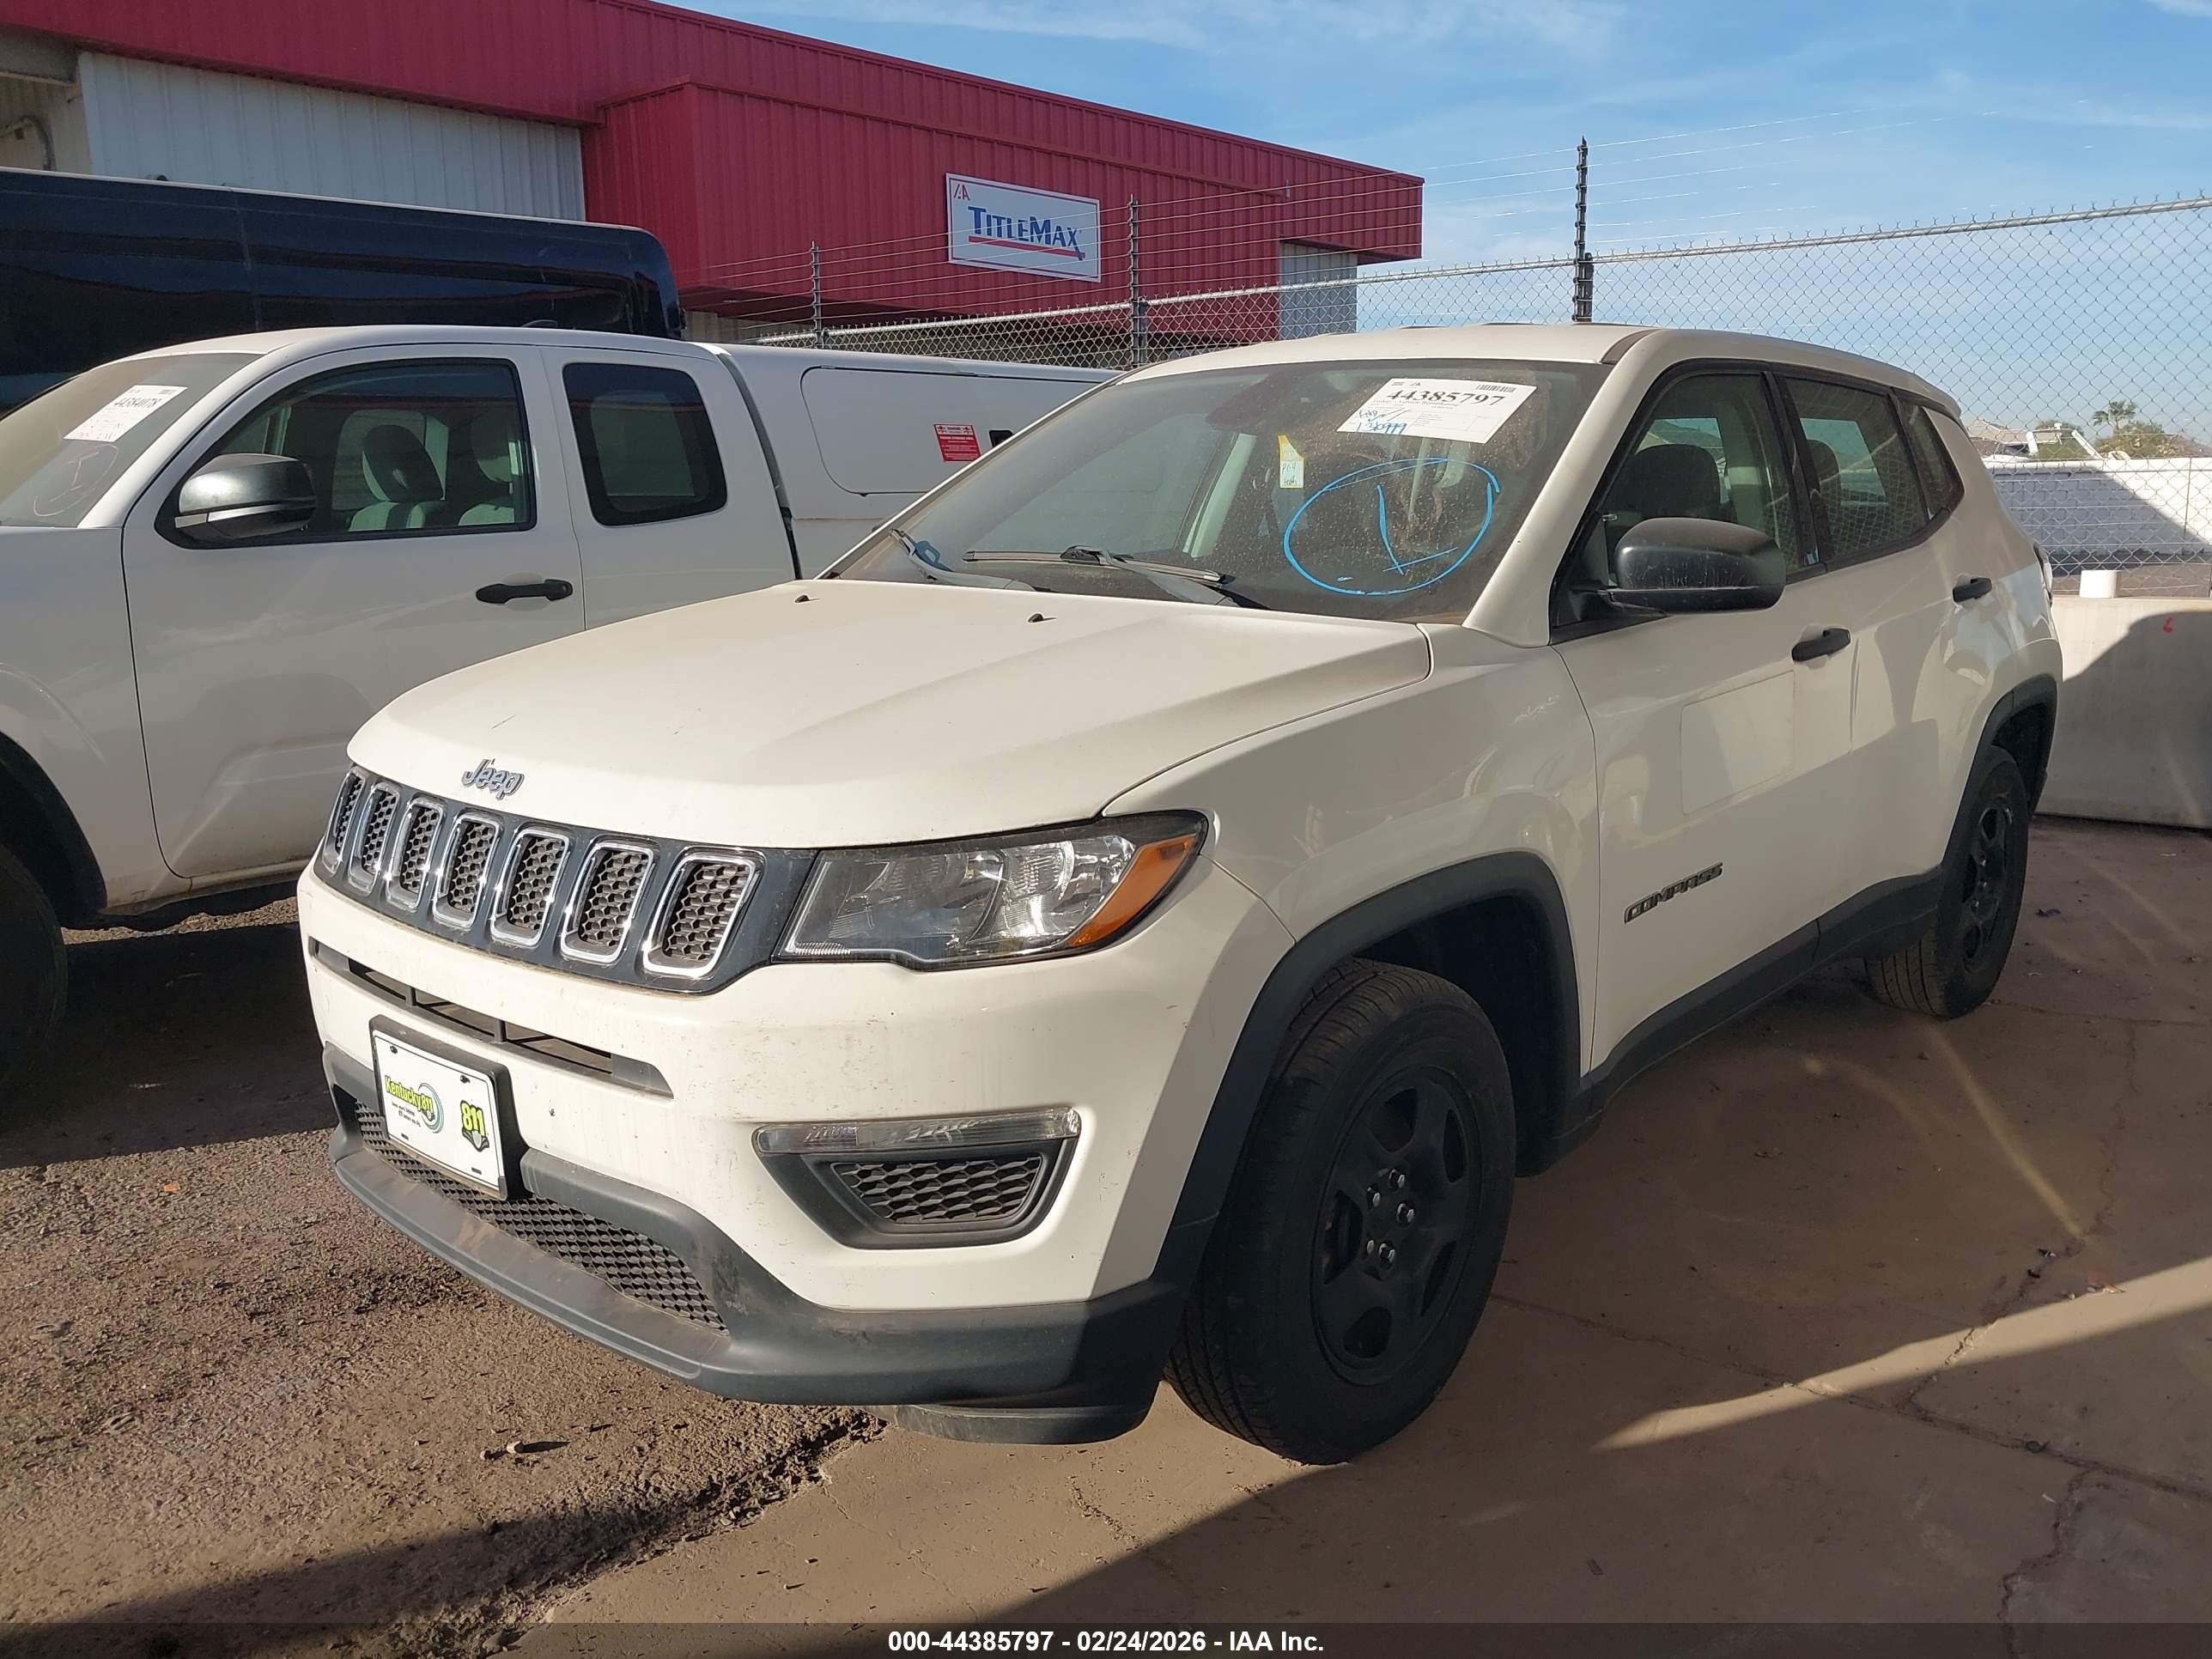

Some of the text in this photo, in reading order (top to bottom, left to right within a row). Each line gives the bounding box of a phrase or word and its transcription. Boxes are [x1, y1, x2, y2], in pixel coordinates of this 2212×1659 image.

[1388, 389, 1507, 406] 44385797
[462, 758, 525, 800] Jeep
[385, 1075, 422, 1112] Kentucky
[460, 1100, 486, 1137] 811
